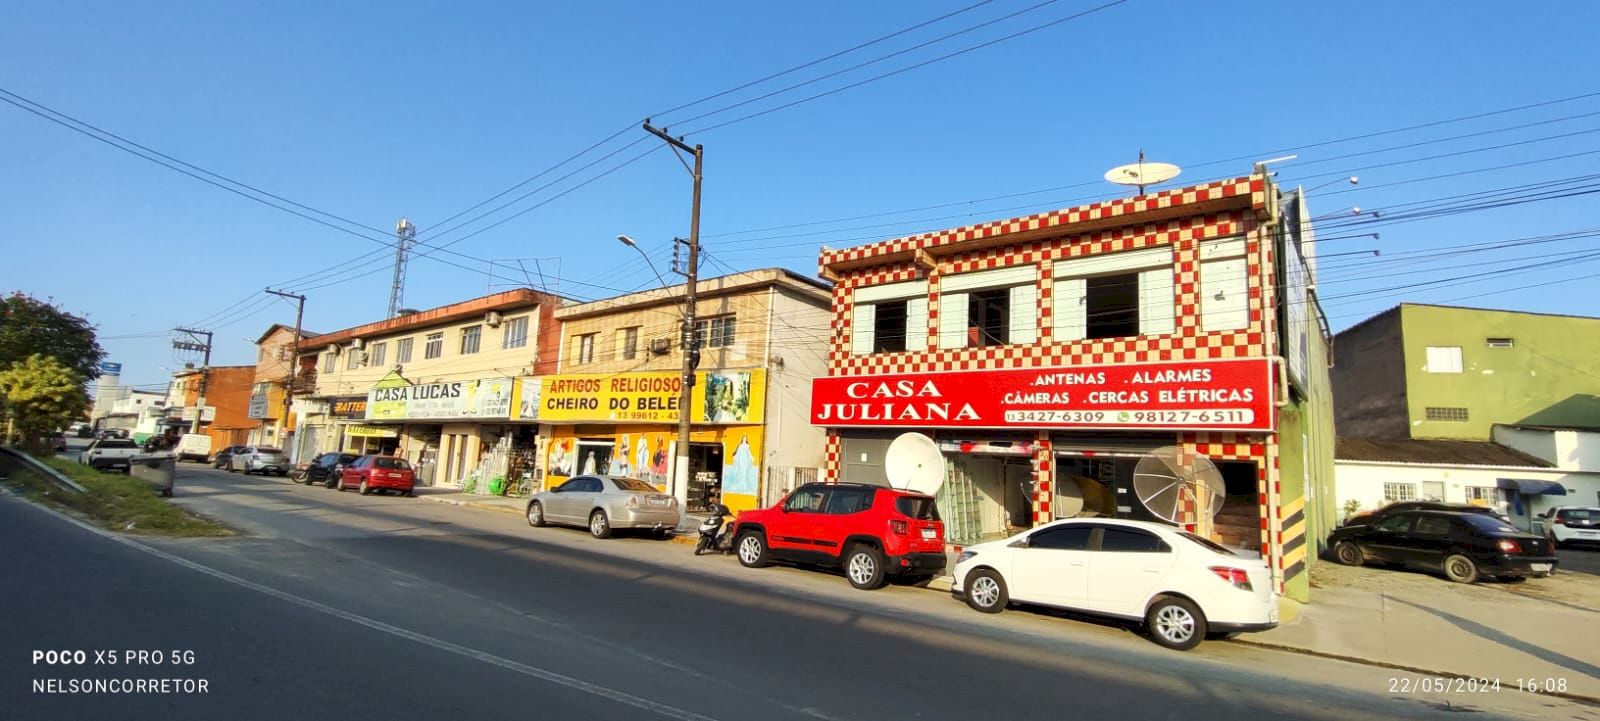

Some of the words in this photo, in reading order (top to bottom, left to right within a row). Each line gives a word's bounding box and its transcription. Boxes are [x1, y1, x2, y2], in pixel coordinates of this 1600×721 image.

[374, 387, 408, 402] CASA
[412, 382, 461, 400] LUCAS
[549, 378, 601, 393] ARTIGOS
[610, 376, 681, 393] RELIGIOSO
[846, 379, 943, 399] CASA
[546, 396, 599, 410] CHEIRO
[609, 396, 630, 410] DO
[1158, 386, 1254, 403] ELÉTRICAS
[617, 411, 628, 419] 13
[631, 411, 658, 420] 99612
[667, 412, 679, 420] 43
[816, 402, 982, 421] JULIANA
[1017, 411, 1105, 422] 3427-6309
[1134, 410, 1245, 422] 98127-6511
